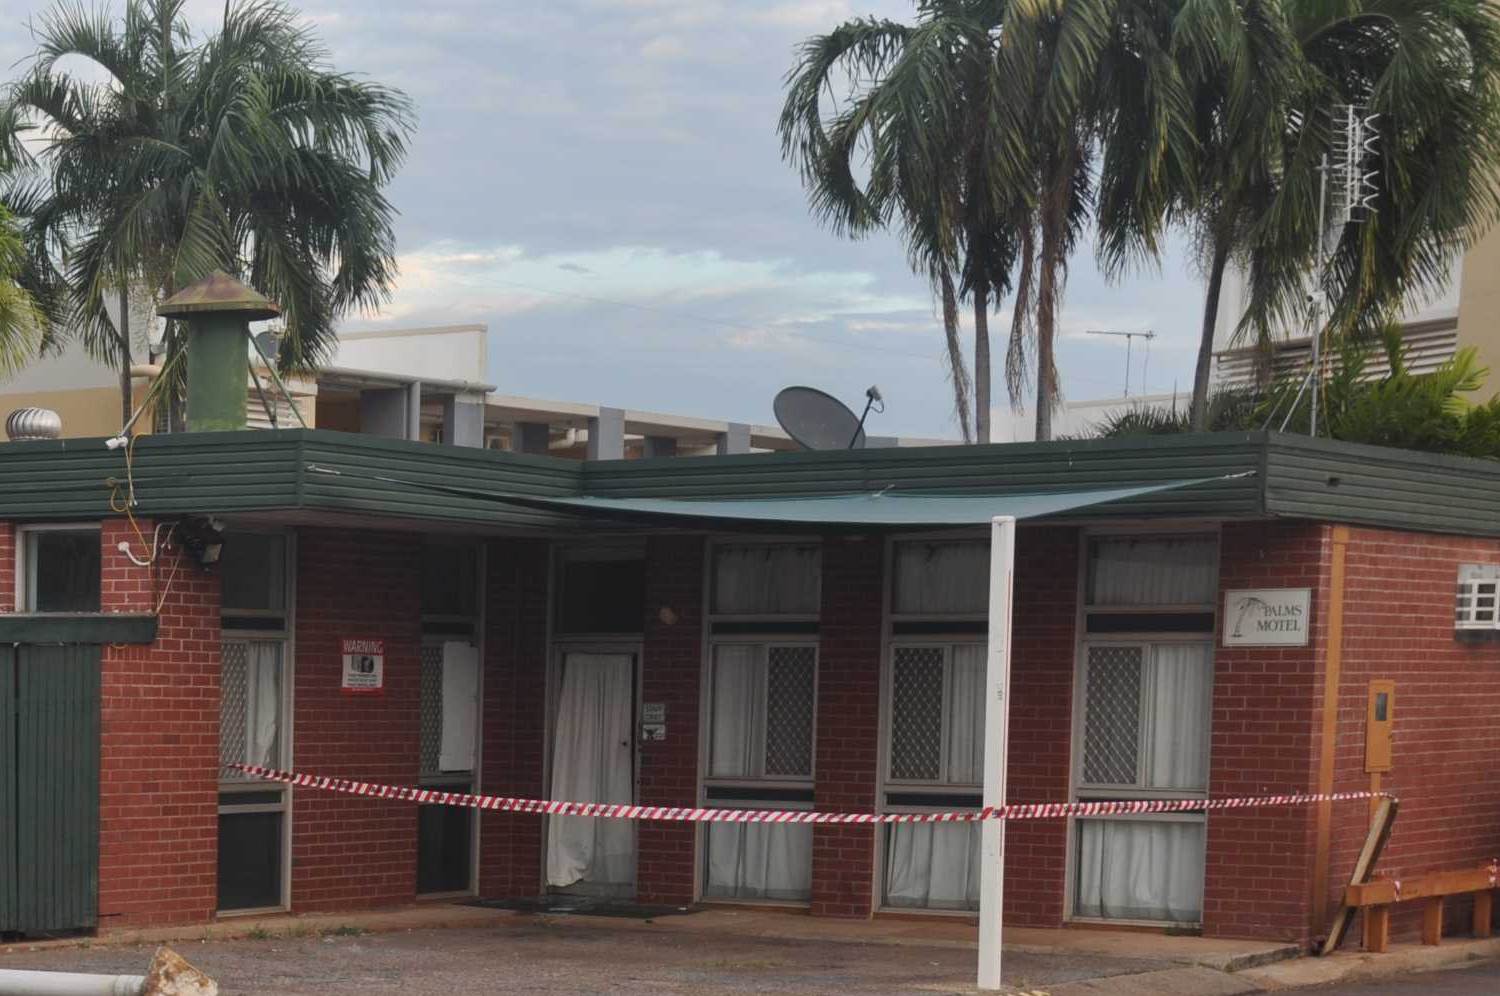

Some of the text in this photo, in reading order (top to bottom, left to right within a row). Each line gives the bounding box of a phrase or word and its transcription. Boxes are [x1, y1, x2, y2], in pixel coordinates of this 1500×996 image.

[1264, 605, 1302, 617] PALMS
[1256, 619, 1301, 632] MOTEL
[343, 639, 384, 653] WARNING
